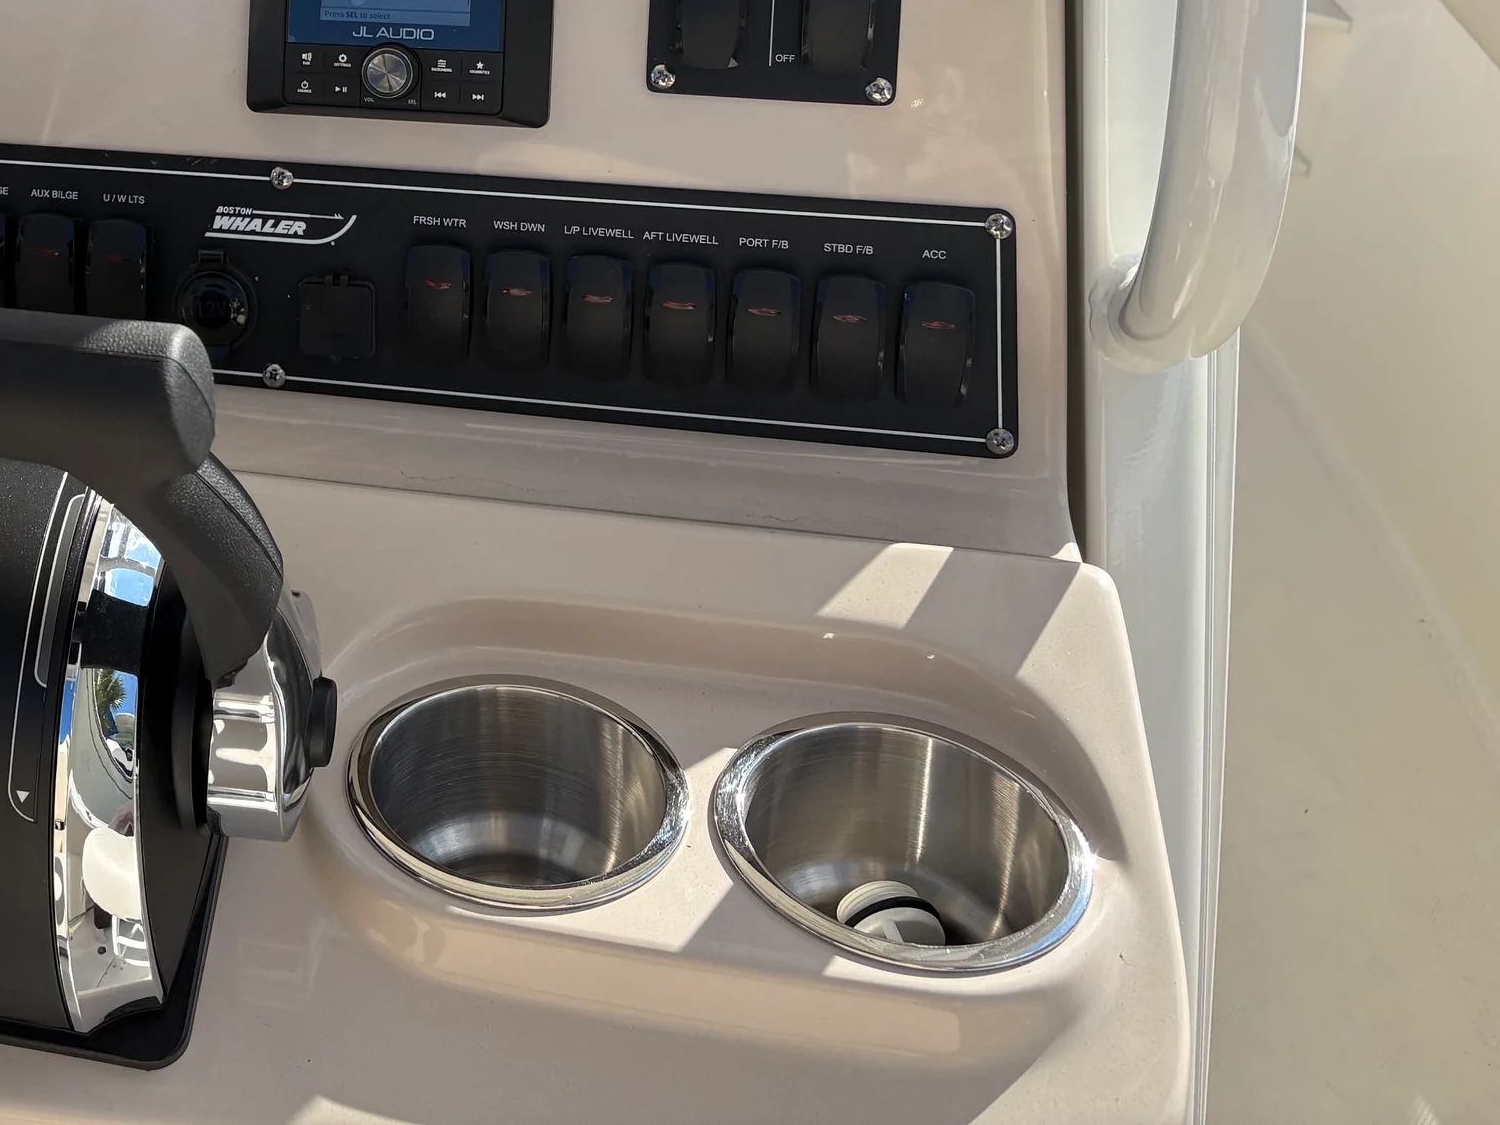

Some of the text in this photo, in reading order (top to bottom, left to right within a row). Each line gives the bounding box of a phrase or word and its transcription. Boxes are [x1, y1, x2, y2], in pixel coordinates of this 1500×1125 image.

[325, 10, 344, 18] Press
[345, 11, 358, 19] SEL
[369, 12, 390, 20] select
[352, 26, 435, 40] JL AUDIO
[775, 54, 795, 63] OFF
[30, 188, 79, 200] AUX BILGE
[128, 195, 145, 204] LTS
[216, 206, 252, 215] BOSTON
[212, 215, 307, 235] WHALER
[413, 215, 467, 228] FRSH WTR
[493, 220, 545, 232] WSH DWN
[564, 225, 634, 239] L/P LIVEWELL
[643, 231, 719, 245] AFT LIVEWELL
[739, 237, 789, 249] PORT F/B
[824, 243, 874, 255] STBD F/B
[922, 249, 947, 260] ACC
